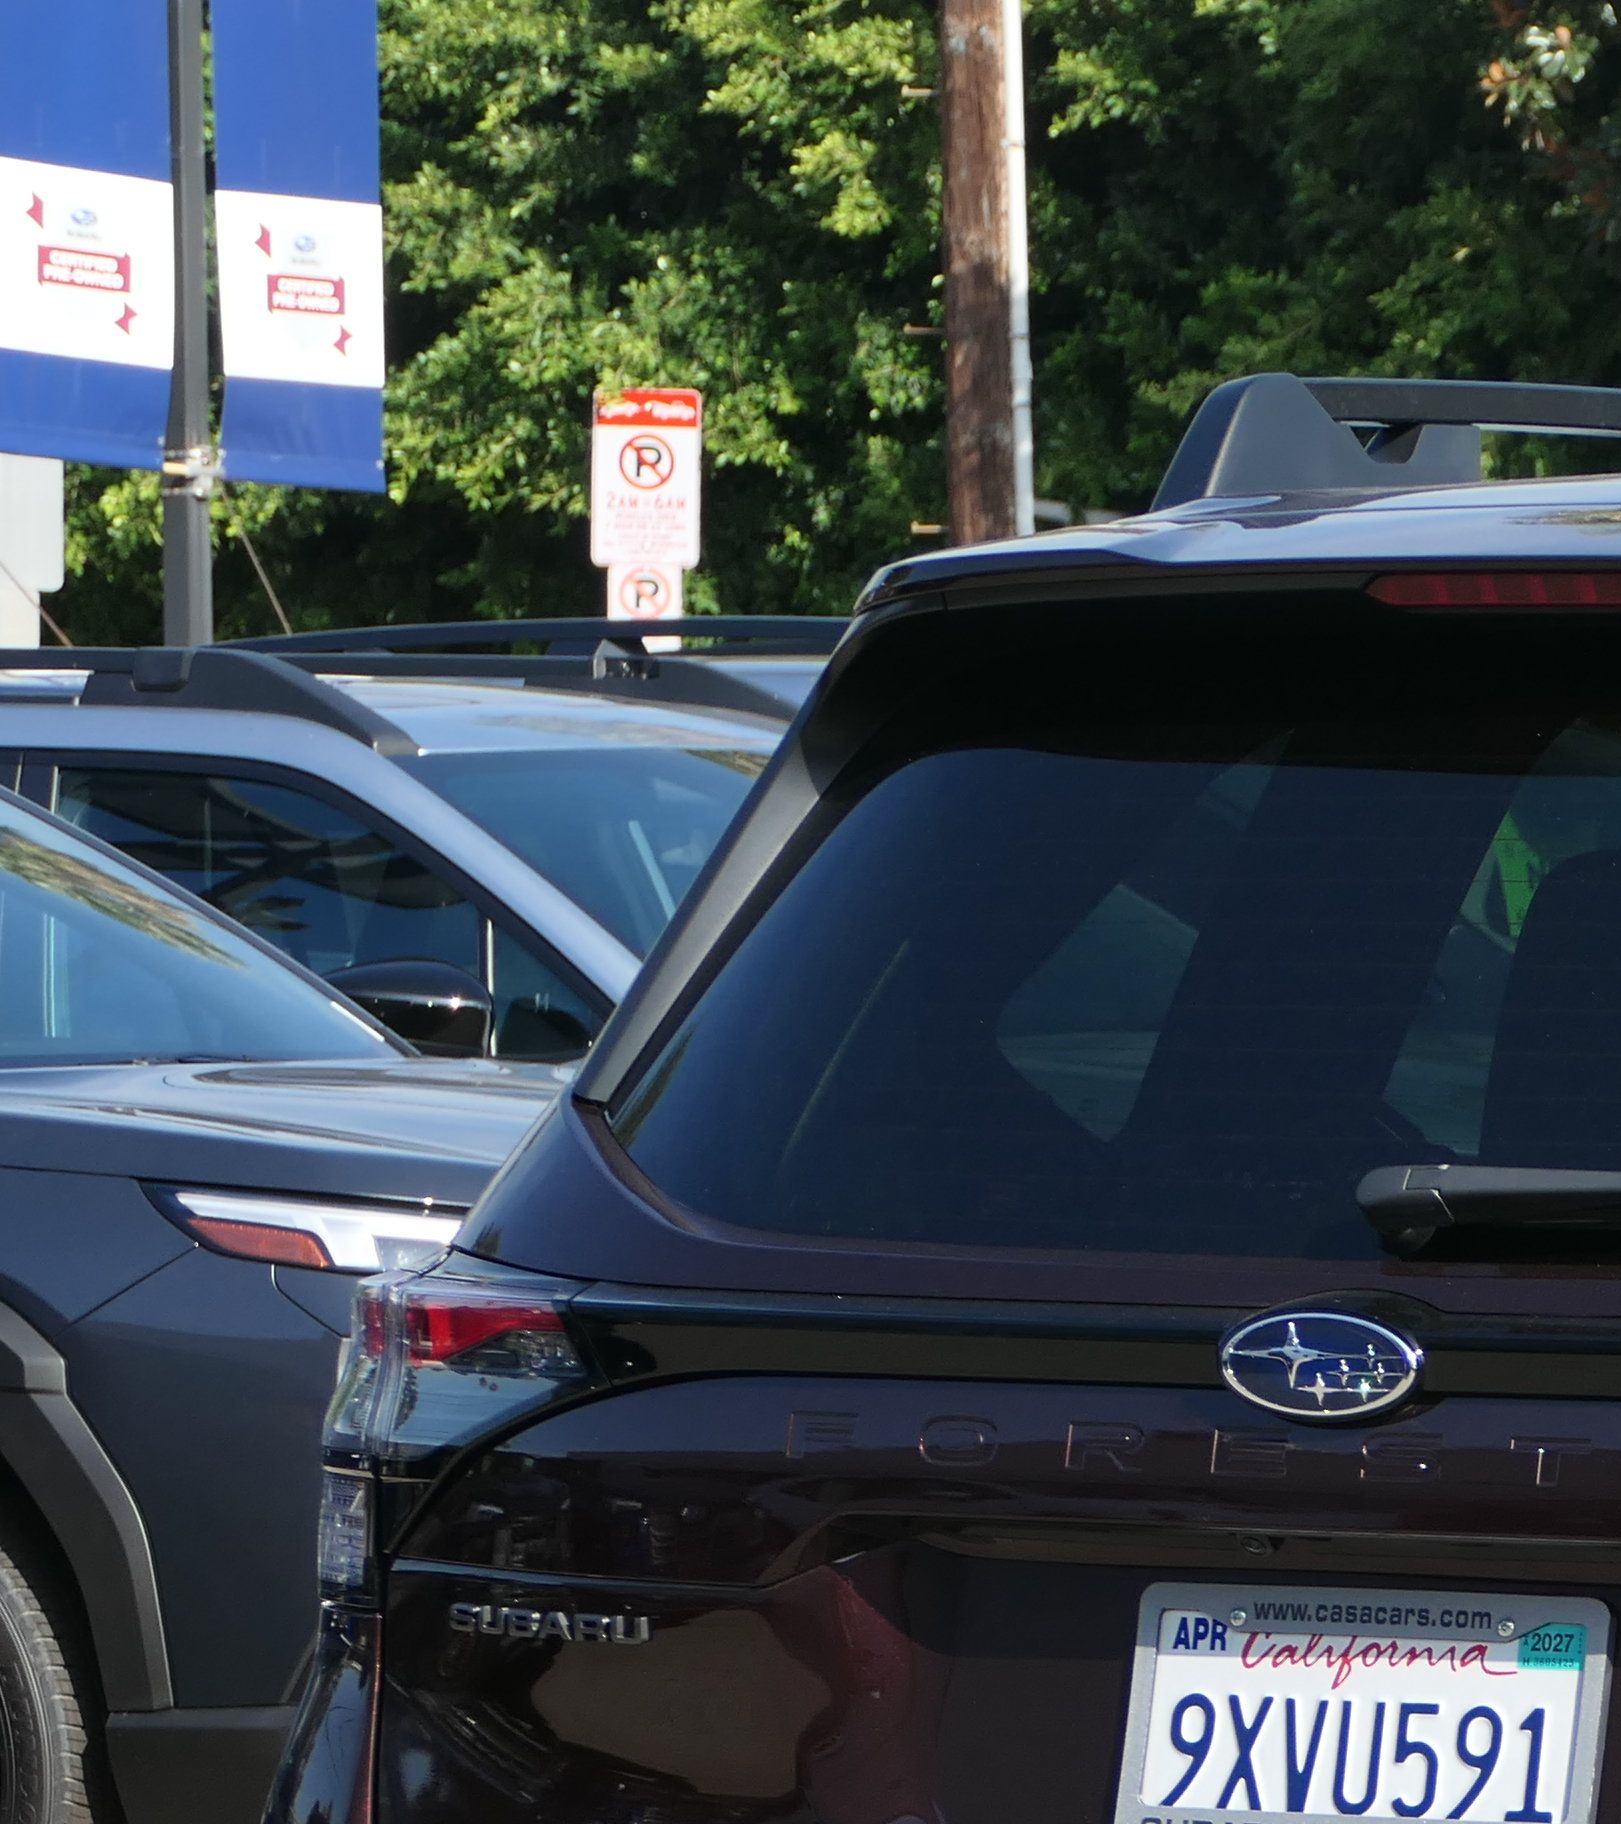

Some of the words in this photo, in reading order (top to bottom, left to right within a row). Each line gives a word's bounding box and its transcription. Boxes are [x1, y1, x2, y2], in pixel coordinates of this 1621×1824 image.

[448, 1602, 653, 1646] SUBARU
[1253, 1601, 1492, 1631] www.casacars.com
[1173, 1617, 1228, 1652] APR
[1531, 1633, 1575, 1654] 2027
